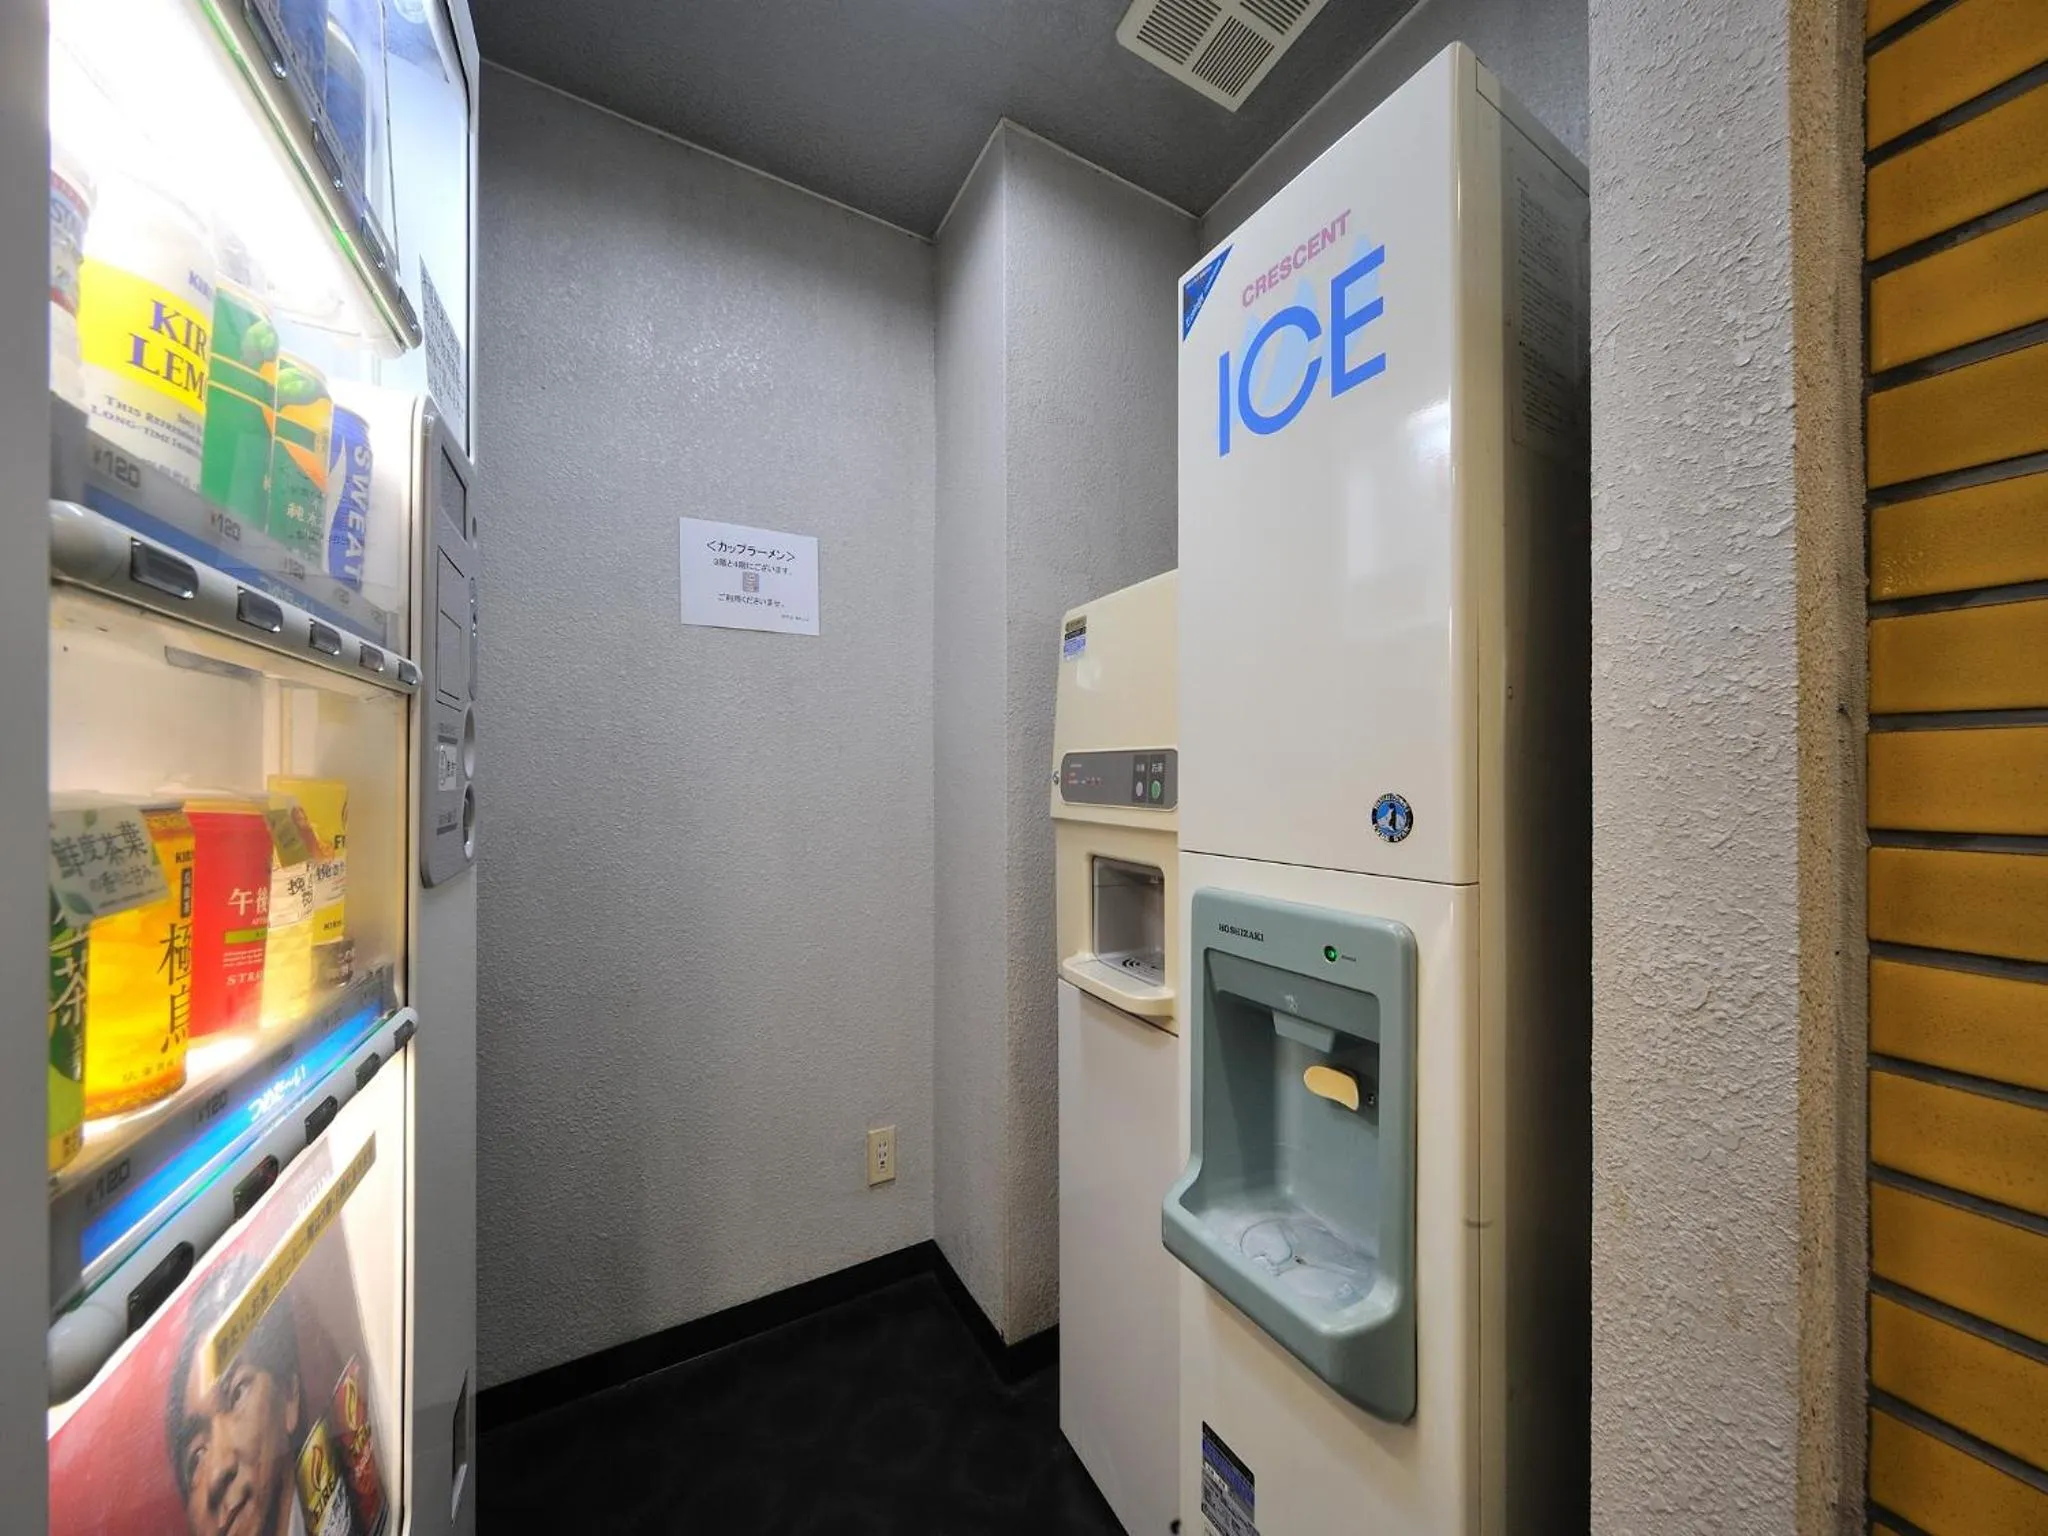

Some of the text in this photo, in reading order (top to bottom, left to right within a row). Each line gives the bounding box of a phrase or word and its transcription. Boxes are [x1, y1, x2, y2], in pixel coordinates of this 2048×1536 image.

[1241, 209, 1352, 309] CRESCENT
[1218, 244, 1386, 458] ICE
[344, 444, 373, 588] SWEAT
[1218, 922, 1264, 942] HOSHIZAKI
